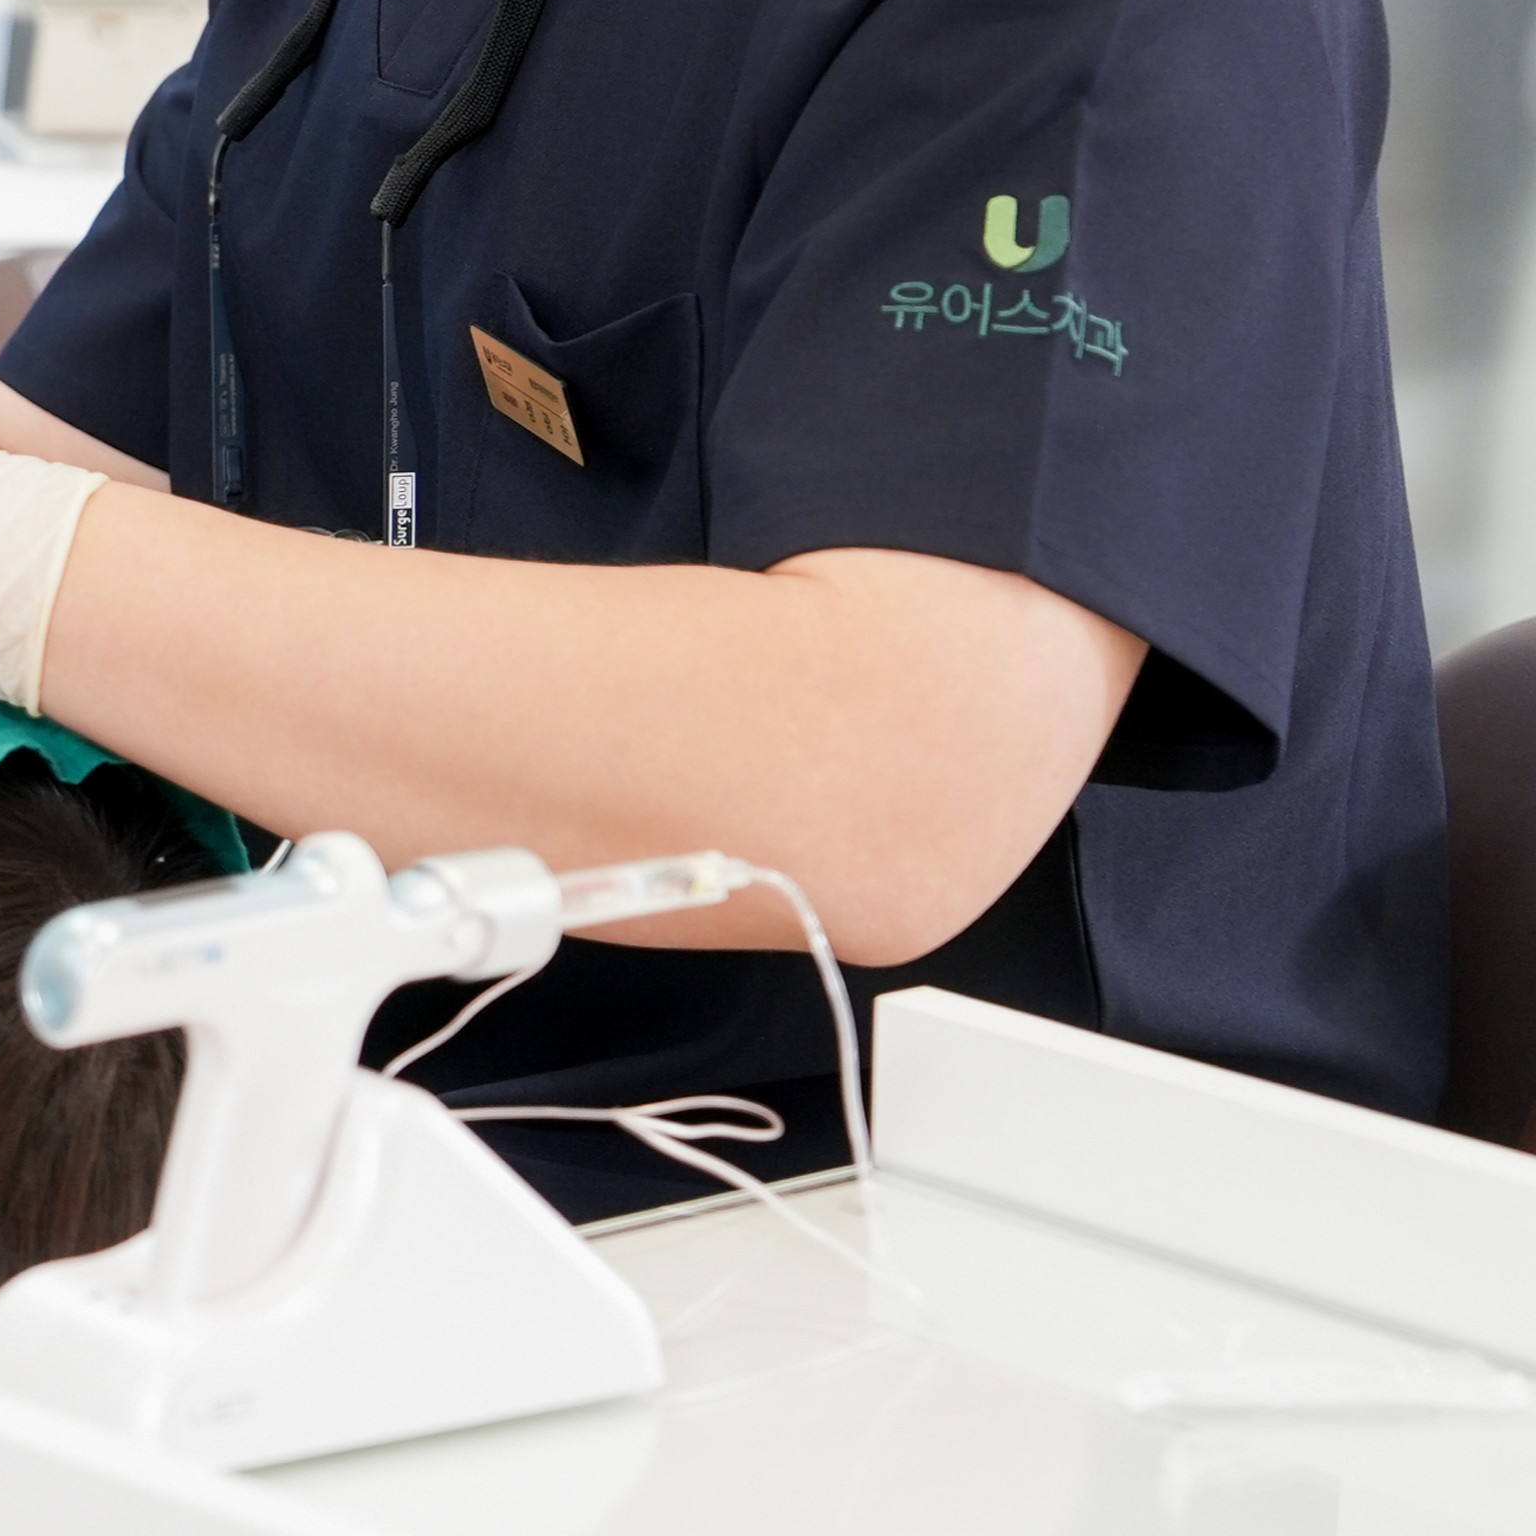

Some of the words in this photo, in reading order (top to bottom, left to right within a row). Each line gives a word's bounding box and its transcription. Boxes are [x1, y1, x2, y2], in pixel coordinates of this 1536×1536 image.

[983, 194, 1071, 272] U
[389, 381, 400, 406] Jung
[389, 408, 400, 455] Kwangho
